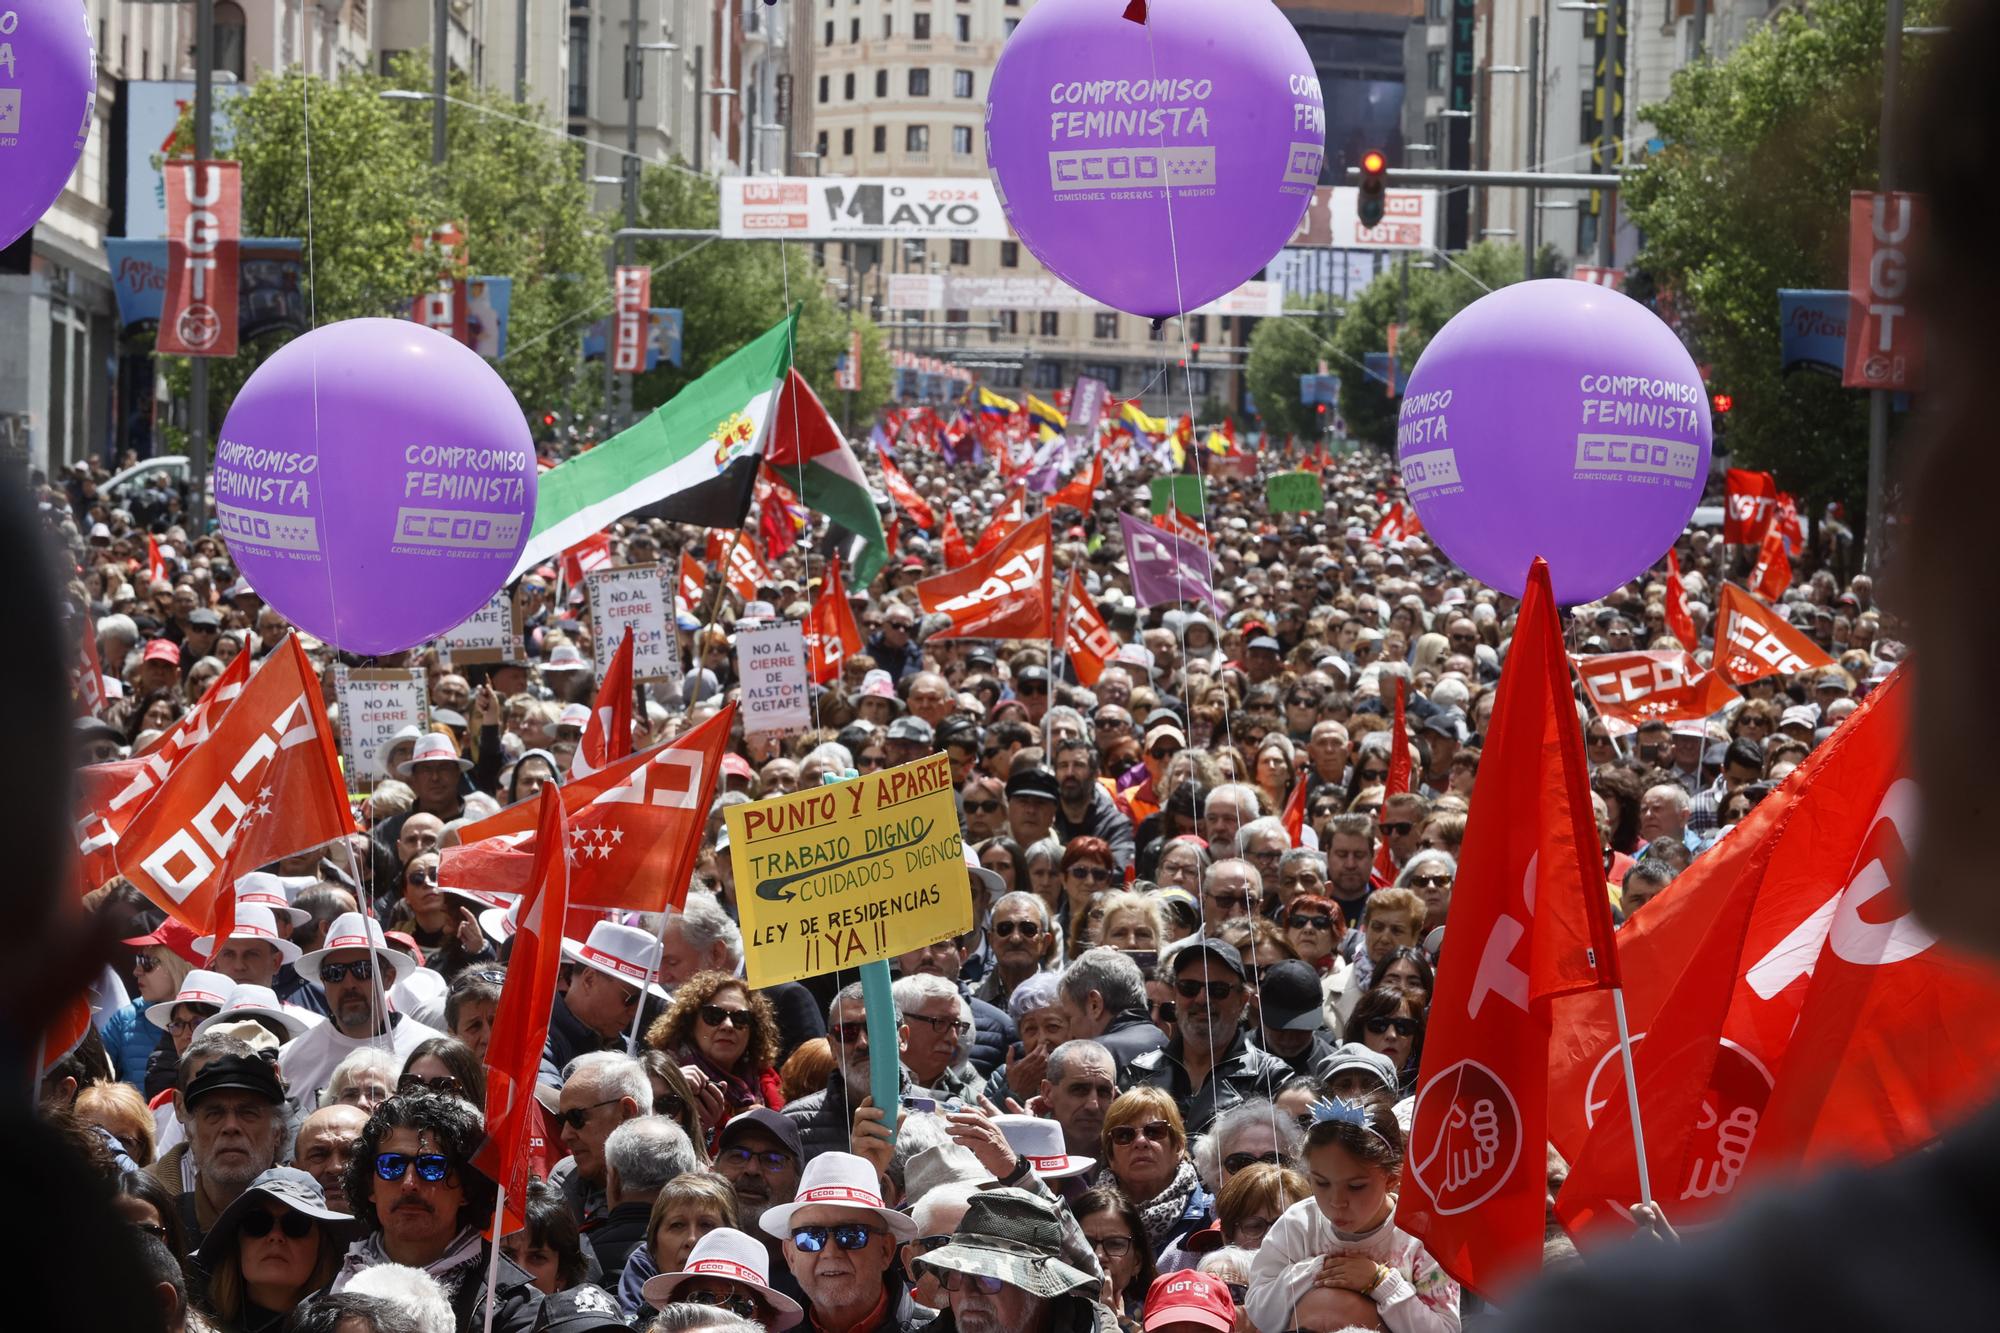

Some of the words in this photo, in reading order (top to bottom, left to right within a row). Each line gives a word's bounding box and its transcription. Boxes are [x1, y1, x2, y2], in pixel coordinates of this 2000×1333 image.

[1050, 79, 1213, 105] COMPROMISO
[1051, 107, 1210, 141] FEMINISTA
[1056, 156, 1158, 182] CCOO
[927, 190, 980, 201] 2024
[1054, 193, 1105, 201] COMISIONES
[1110, 191, 1153, 200] OBRERAS
[1178, 188, 1216, 198] MADRID
[184, 166, 221, 300] UGT
[1358, 223, 1401, 242] UGT
[1870, 194, 1912, 353] UGT
[1580, 375, 1698, 404] COMPROMISO
[1582, 399, 1698, 437] FEMINISTA
[219, 440, 318, 474] COMPROMISO
[405, 444, 526, 472] COMPROMISO
[1583, 441, 1669, 467] CCOO
[216, 466, 311, 509] FEMINISTA
[405, 472, 525, 506] FEMINISTA
[403, 515, 491, 541] CCOO
[610, 592, 628, 603] NO
[632, 590, 647, 601] AL
[608, 602, 653, 618] CIERRE
[594, 615, 606, 665] ALSTOM
[664, 612, 678, 663] ALSTOM
[752, 644, 771, 655] NO
[775, 642, 790, 653] AL
[750, 656, 796, 671] CIERRE
[349, 681, 399, 692] ALSTOM
[766, 672, 783, 683] DE
[364, 699, 383, 709] NO
[387, 699, 404, 708] AL
[748, 683, 803, 699] ALSTOM
[751, 696, 802, 712] GETAFE
[361, 710, 408, 722] CIERRE
[376, 724, 395, 735] DE
[744, 792, 836, 841] PUNTO
[846, 781, 865, 815] Y
[877, 756, 951, 808] APARTE
[749, 836, 850, 880] TRABAJO
[864, 816, 924, 852] DIGNO
[800, 858, 894, 902] CUIDADOS
[906, 832, 963, 874] DIGNOS
[752, 922, 788, 947] LEY
[800, 916, 819, 937] DE
[828, 883, 941, 930] RESIDENCIAS
[812, 1190, 835, 1198] CCOO
[1166, 1280, 1192, 1294] UGT
